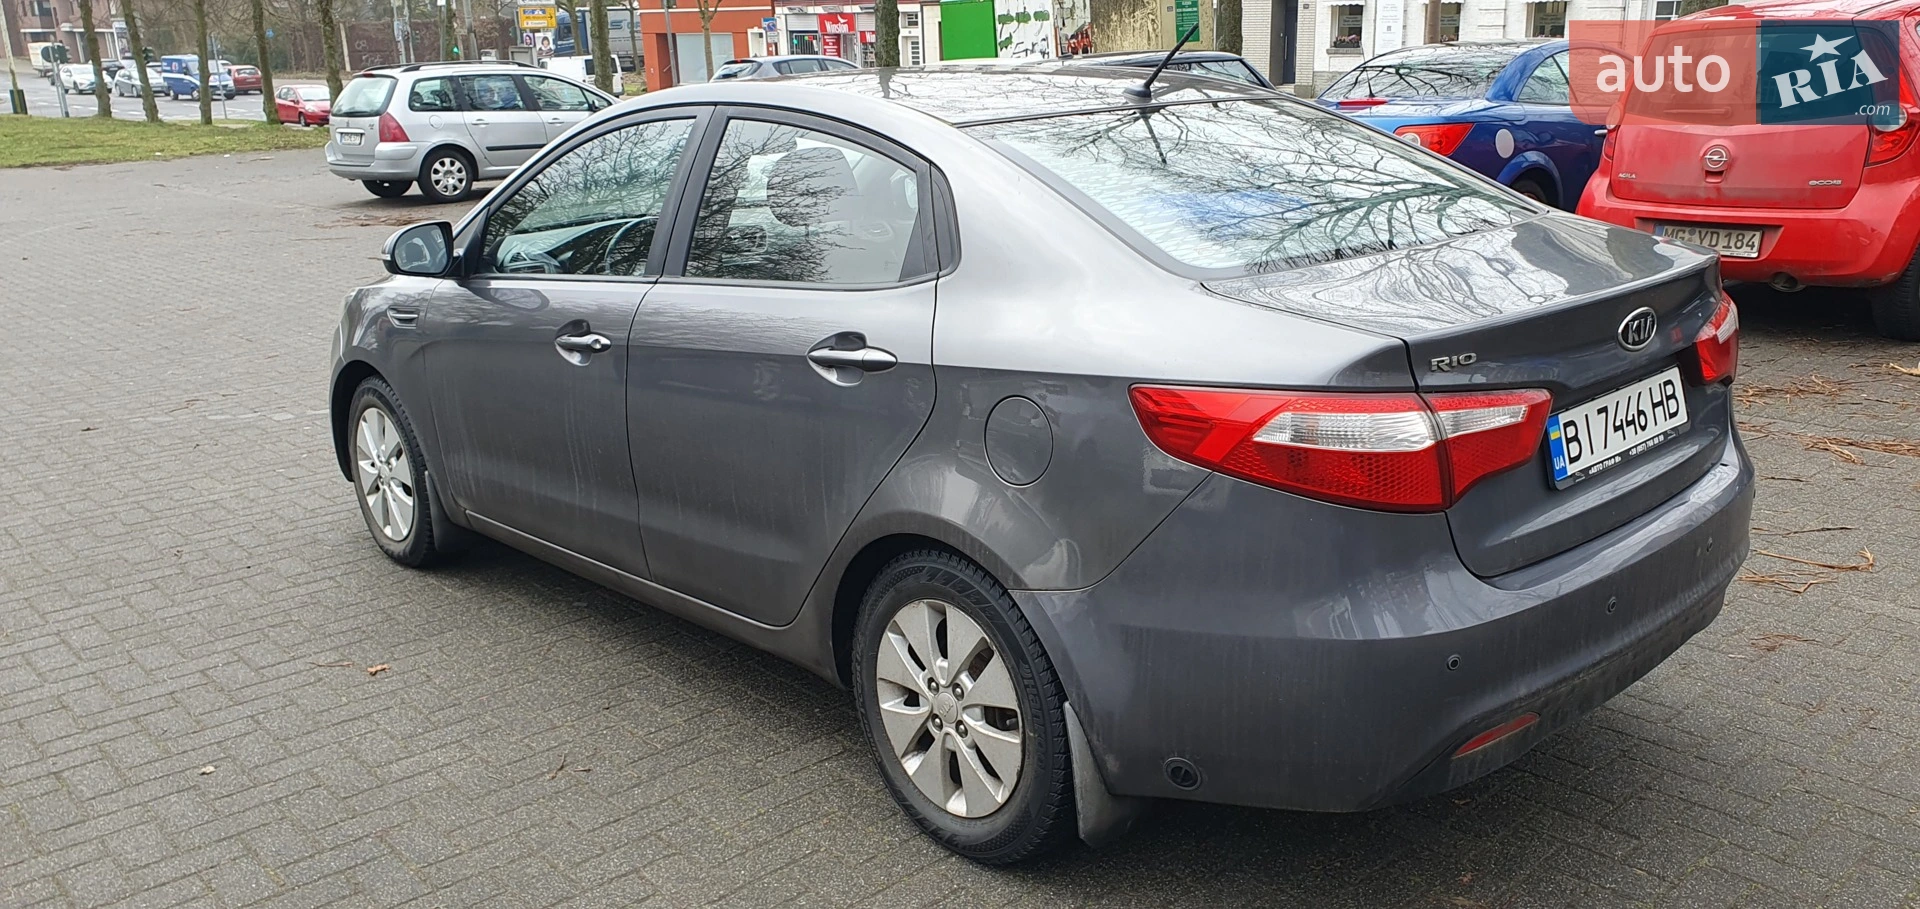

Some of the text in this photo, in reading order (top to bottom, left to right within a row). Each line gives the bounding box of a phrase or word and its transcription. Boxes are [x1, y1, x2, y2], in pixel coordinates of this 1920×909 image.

[824, 19, 849, 33] Winston
[865, 32, 876, 43] Win
[1698, 229, 1720, 248] YD
[1721, 231, 1757, 251] 184
[1627, 316, 1654, 345] KIA
[1431, 352, 1477, 373] RIO
[1562, 379, 1680, 465] BI 7446 HB
[1554, 455, 1566, 471] UA
